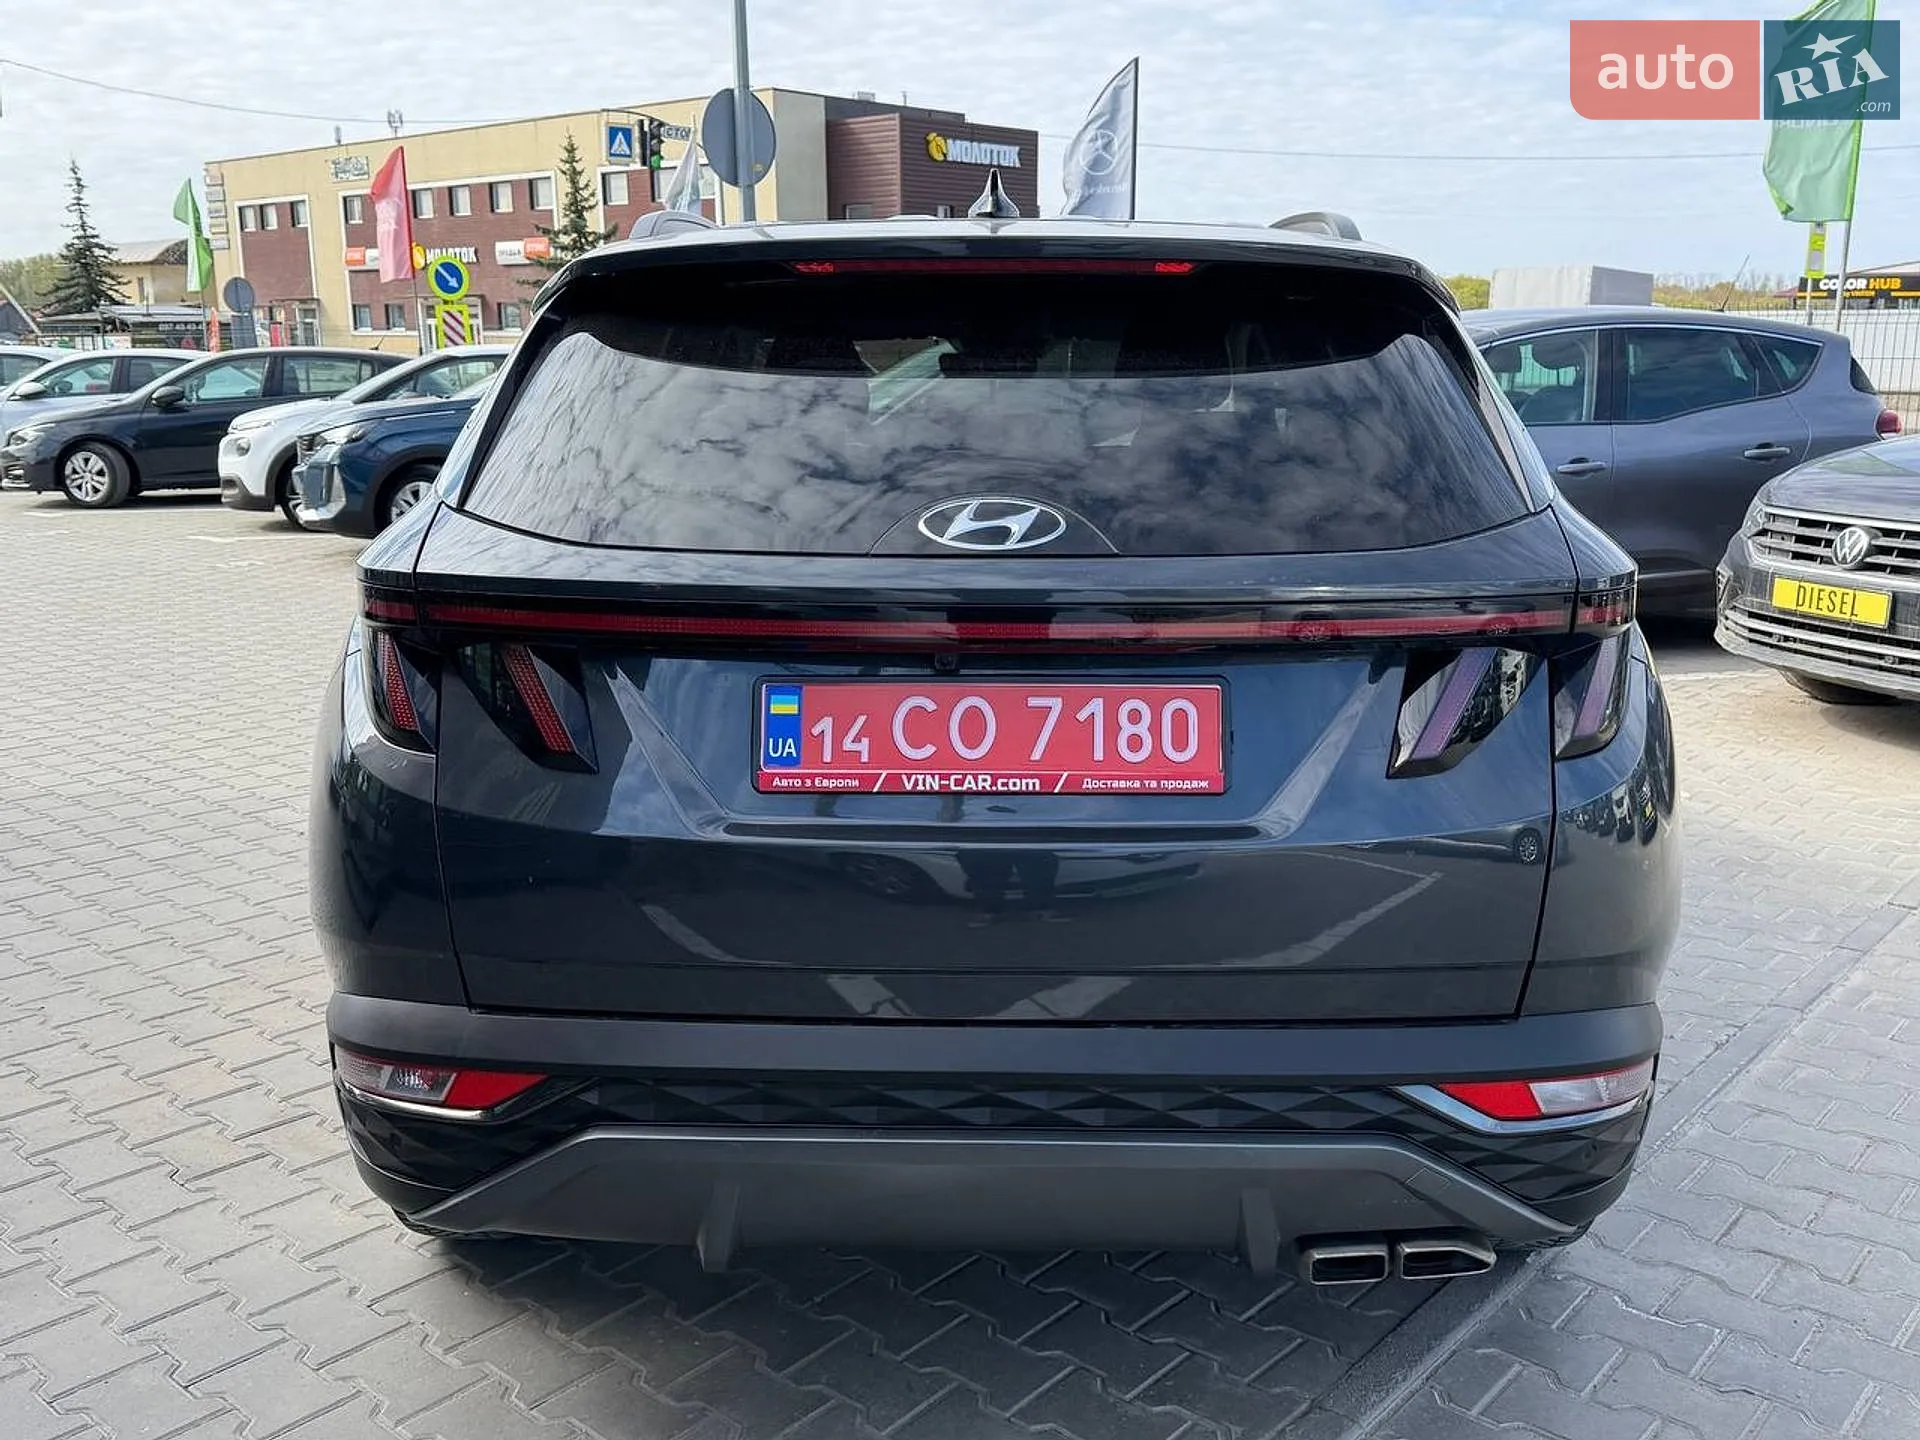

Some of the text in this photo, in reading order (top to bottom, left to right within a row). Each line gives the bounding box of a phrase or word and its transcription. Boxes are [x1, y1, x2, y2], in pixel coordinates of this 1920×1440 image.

[946, 138, 1021, 168] МОЛОТОК
[1819, 277, 1902, 290] COOR HUB
[1796, 584, 1858, 617] DIESEL
[810, 695, 1199, 764] 14 CO 7180
[768, 737, 797, 758] UA
[772, 776, 801, 787] Авто
[814, 776, 859, 789] Європи
[901, 774, 1040, 791] VIN-CAR.com
[1081, 778, 1209, 790] Доставка та продаж
